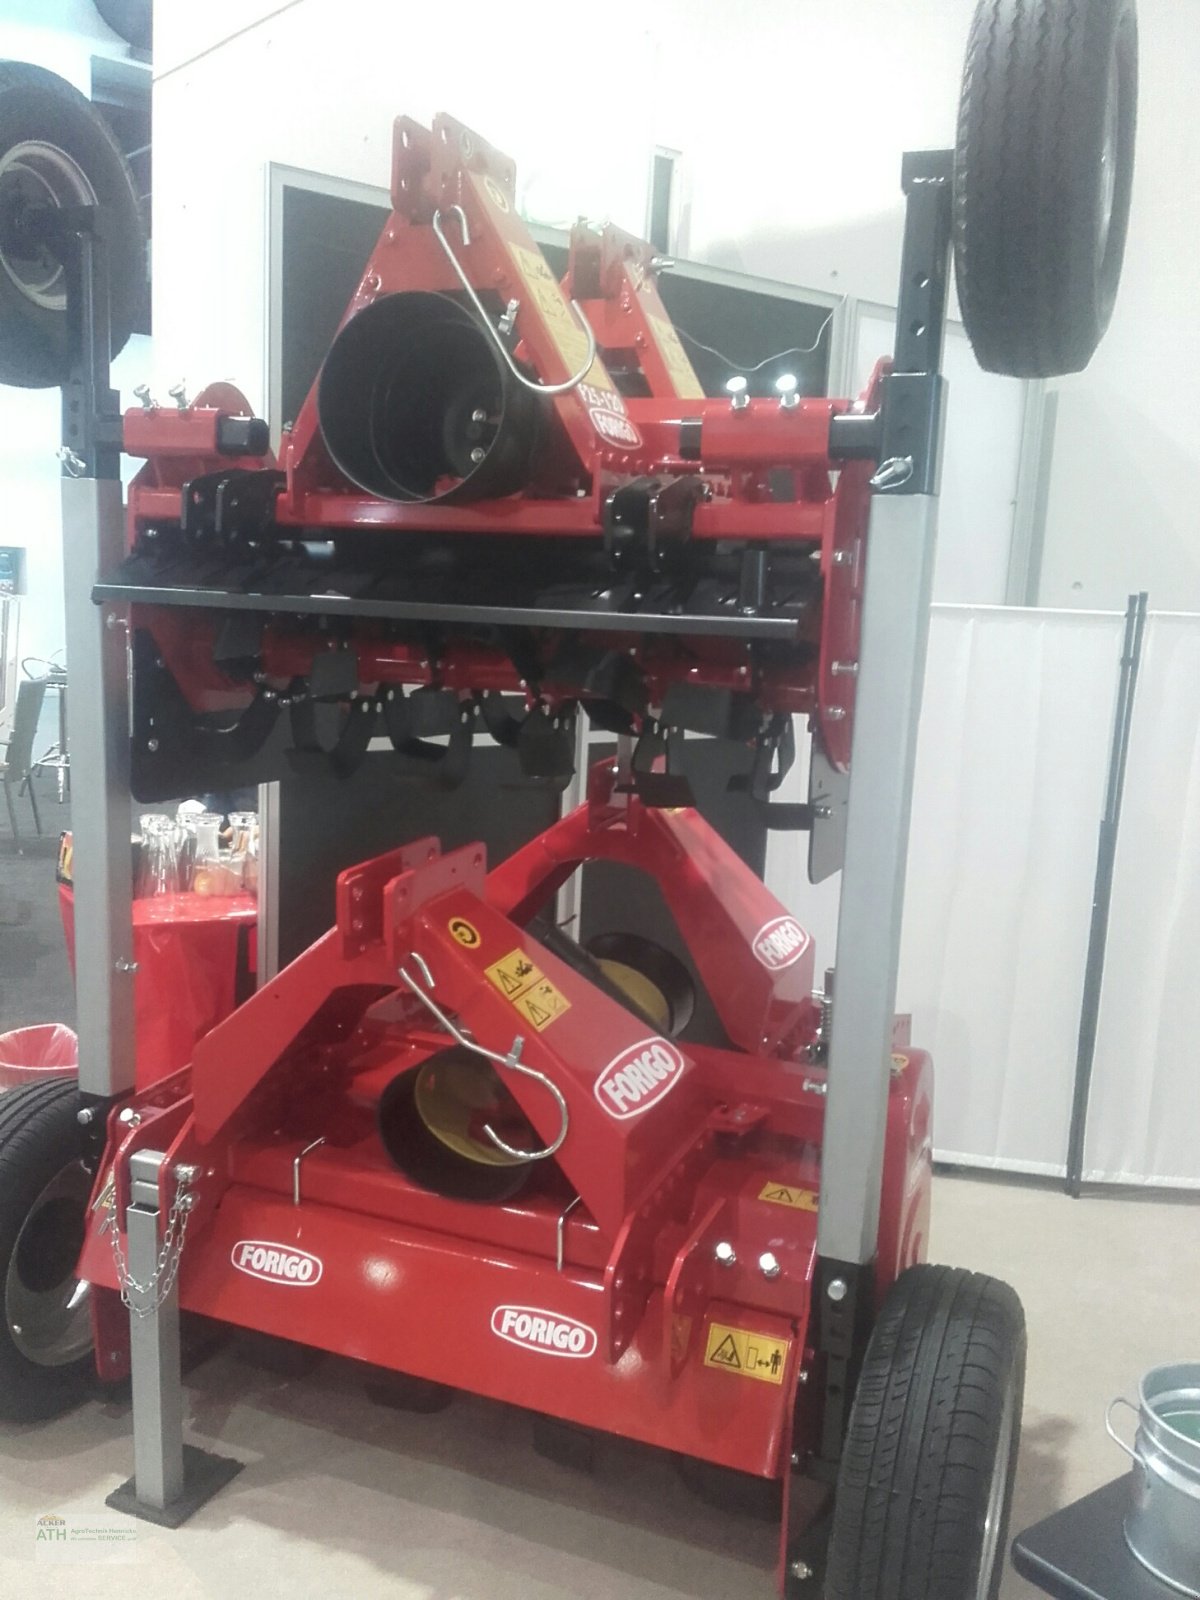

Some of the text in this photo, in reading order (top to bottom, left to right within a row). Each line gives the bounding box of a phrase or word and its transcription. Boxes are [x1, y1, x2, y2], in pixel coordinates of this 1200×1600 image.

[757, 921, 805, 965] FORIGO
[601, 1044, 676, 1113] FORIGO
[239, 1244, 313, 1281] FORIGO
[501, 1309, 586, 1353] FORIGO
